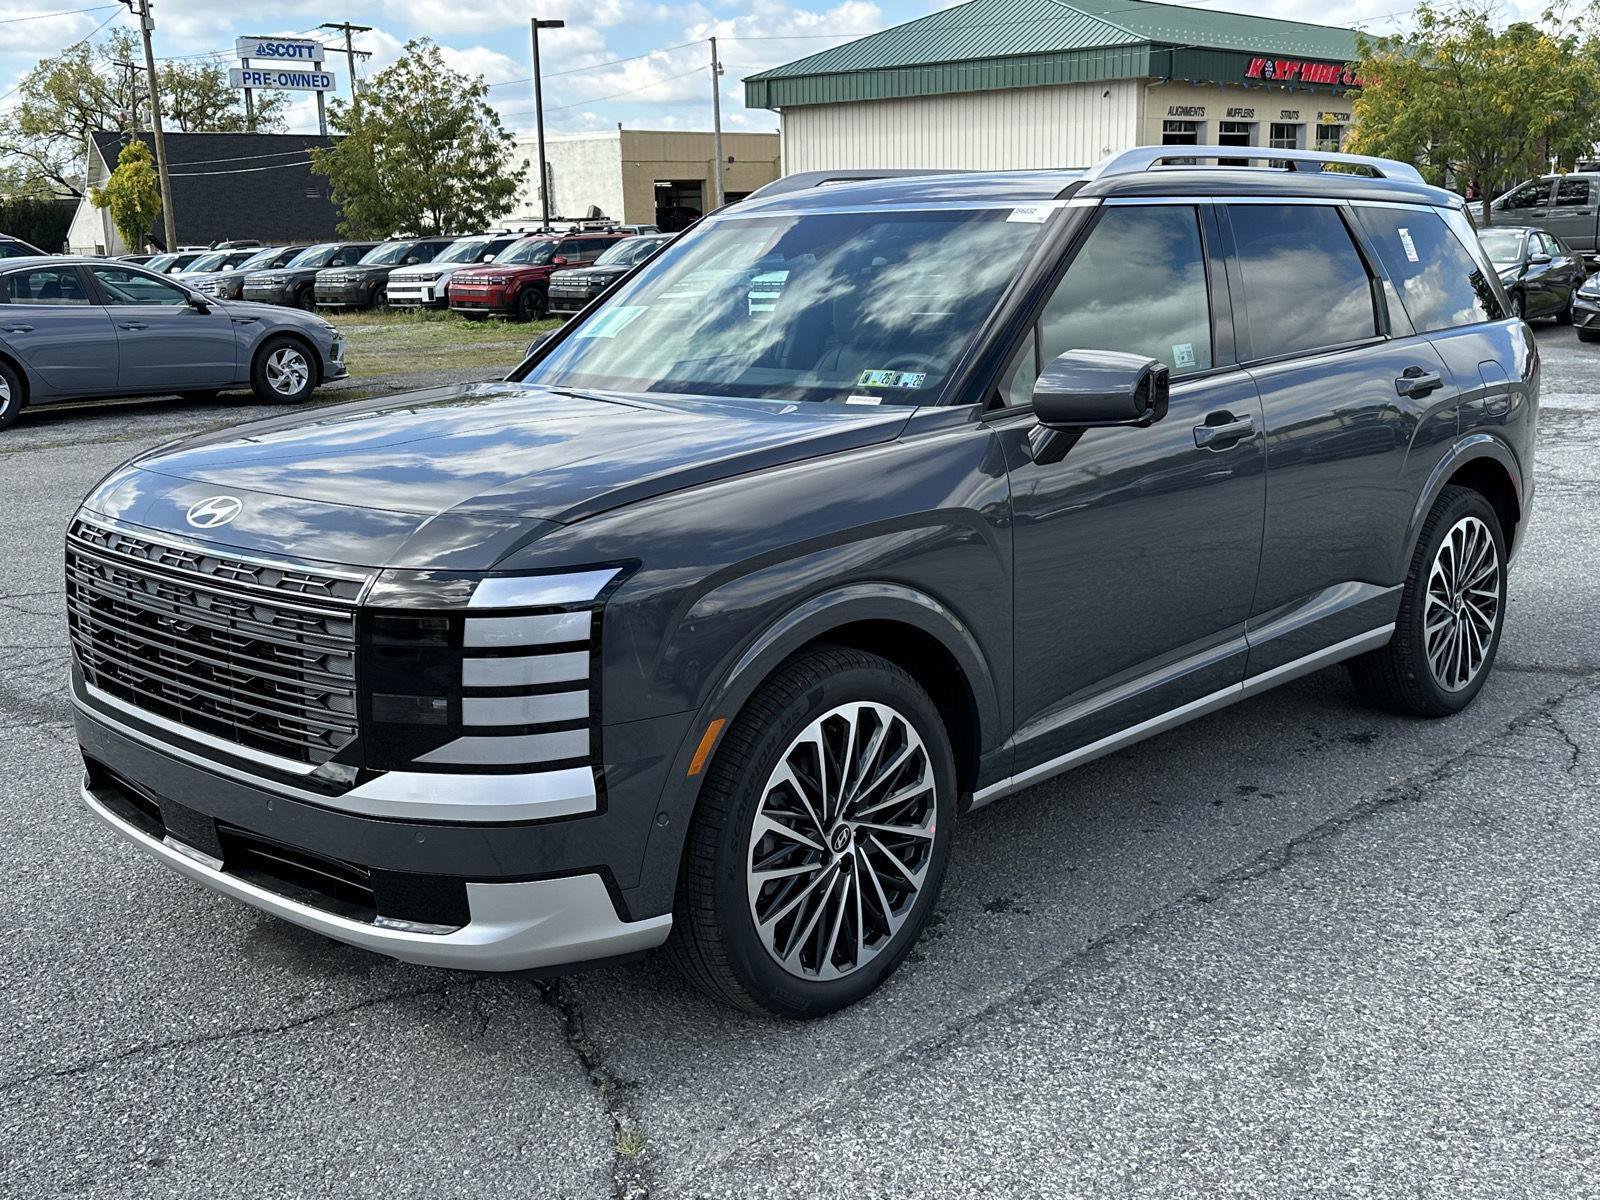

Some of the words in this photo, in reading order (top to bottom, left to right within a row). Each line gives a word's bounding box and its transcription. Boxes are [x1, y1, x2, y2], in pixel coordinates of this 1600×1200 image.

[243, 72, 330, 87] PRE-OWNED
[1167, 106, 1206, 117] ALIGNMENTS
[1226, 107, 1255, 119] MUFFLERS
[1280, 110, 1300, 120] STRUTS
